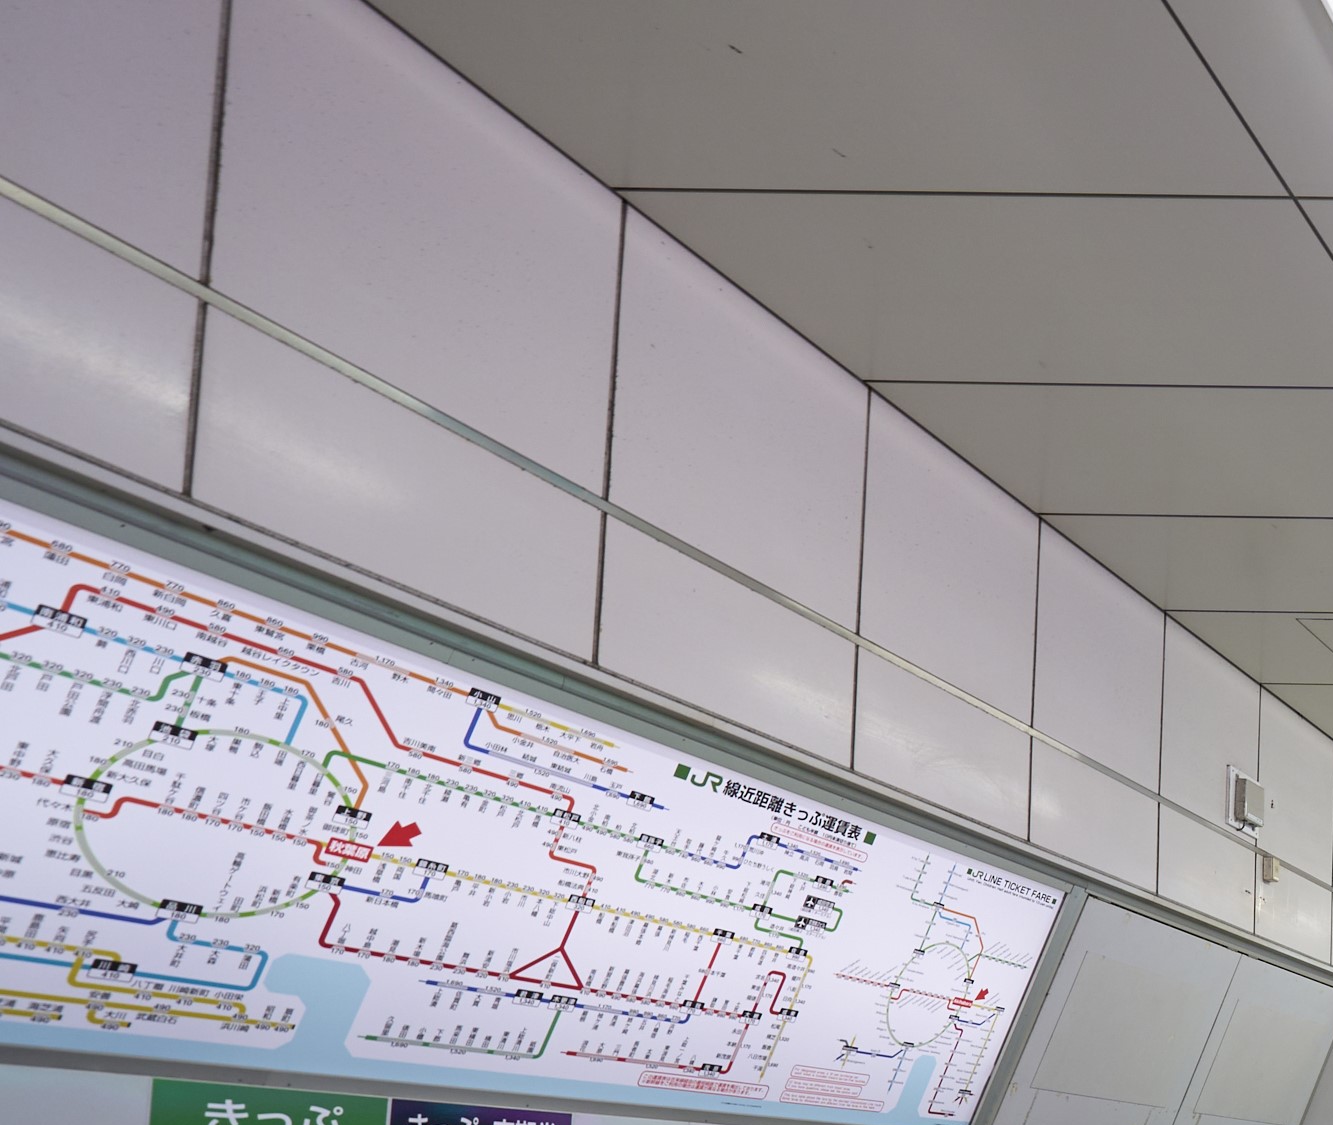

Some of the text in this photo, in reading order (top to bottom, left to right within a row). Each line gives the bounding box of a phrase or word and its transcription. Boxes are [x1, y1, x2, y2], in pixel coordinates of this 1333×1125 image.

[50, 540, 73, 552] 680
[110, 560, 130, 573] 770
[101, 586, 120, 598] 410
[166, 581, 184, 592] 770
[152, 589, 186, 607] 新白岡
[157, 606, 175, 616] 490
[217, 600, 235, 611] 860
[47, 622, 68, 632] 410
[143, 614, 177, 630] 東川口
[266, 617, 284, 627] 860
[99, 627, 118, 638] 320
[208, 624, 226, 634] 580
[127, 637, 147, 647] 320
[196, 632, 227, 647] 南越谷
[312, 633, 329, 643] 990
[155, 646, 174, 656] 230
[278, 647, 295, 656] 660
[11, 652, 32, 663] 320
[241, 646, 320, 678] 越谷レイクタウン
[43, 661, 64, 672] 320
[338, 667, 353, 677] 580
[193, 669, 211, 677] 230
[235, 671, 251, 680] 180
[235, 671, 251, 681] 180
[391, 673, 409, 684] 野木
[103, 679, 122, 689] 230
[132, 687, 150, 697] 230
[284, 686, 299, 695] 180
[427, 685, 452, 699] 間々田
[473, 689, 496, 704] 小山
[189, 710, 211, 722] 板橋
[335, 715, 353, 726] 尾久
[315, 719, 329, 728] 180
[234, 726, 250, 735] 180
[114, 738, 133, 749] 210
[163, 736, 180, 745] 210
[403, 737, 436, 753] 吉川美南
[512, 737, 534, 749] 小金井
[485, 742, 508, 753] 小田林
[89, 755, 107, 766] 180
[142, 749, 165, 762] 目白
[408, 750, 423, 760] 580
[122, 759, 167, 776] 高田馬場
[106, 770, 152, 787] 新大久保
[76, 789, 94, 798] 180
[37, 798, 73, 812] 代々木
[342, 808, 367, 819] 上野
[46, 818, 72, 830] 原宿
[322, 823, 349, 835] 御徒町
[49, 834, 73, 845] 渋谷
[329, 839, 372, 860] 秋葉原
[45, 849, 81, 863] 恵比寿
[69, 868, 93, 879] 目黒
[106, 870, 125, 878] 210
[345, 865, 362, 875] 神田
[564, 868, 589, 880] 市川大野
[81, 884, 116, 898] 五反田
[972, 871, 1051, 903] JR LINE TICKET FARE
[55, 895, 90, 907] 西大井
[117, 900, 139, 910] 大崎
[365, 897, 399, 909] 新日本橋
[165, 900, 197, 914] 品川
[58, 908, 79, 918] 230
[171, 911, 186, 920] 180
[180, 933, 196, 942] 230
[99, 960, 131, 973] 川崎
[102, 970, 120, 980] 410
[168, 984, 209, 997] 川崎新町
[104, 1011, 126, 1020] 大川
[135, 1013, 177, 1025] 武蔵白石
